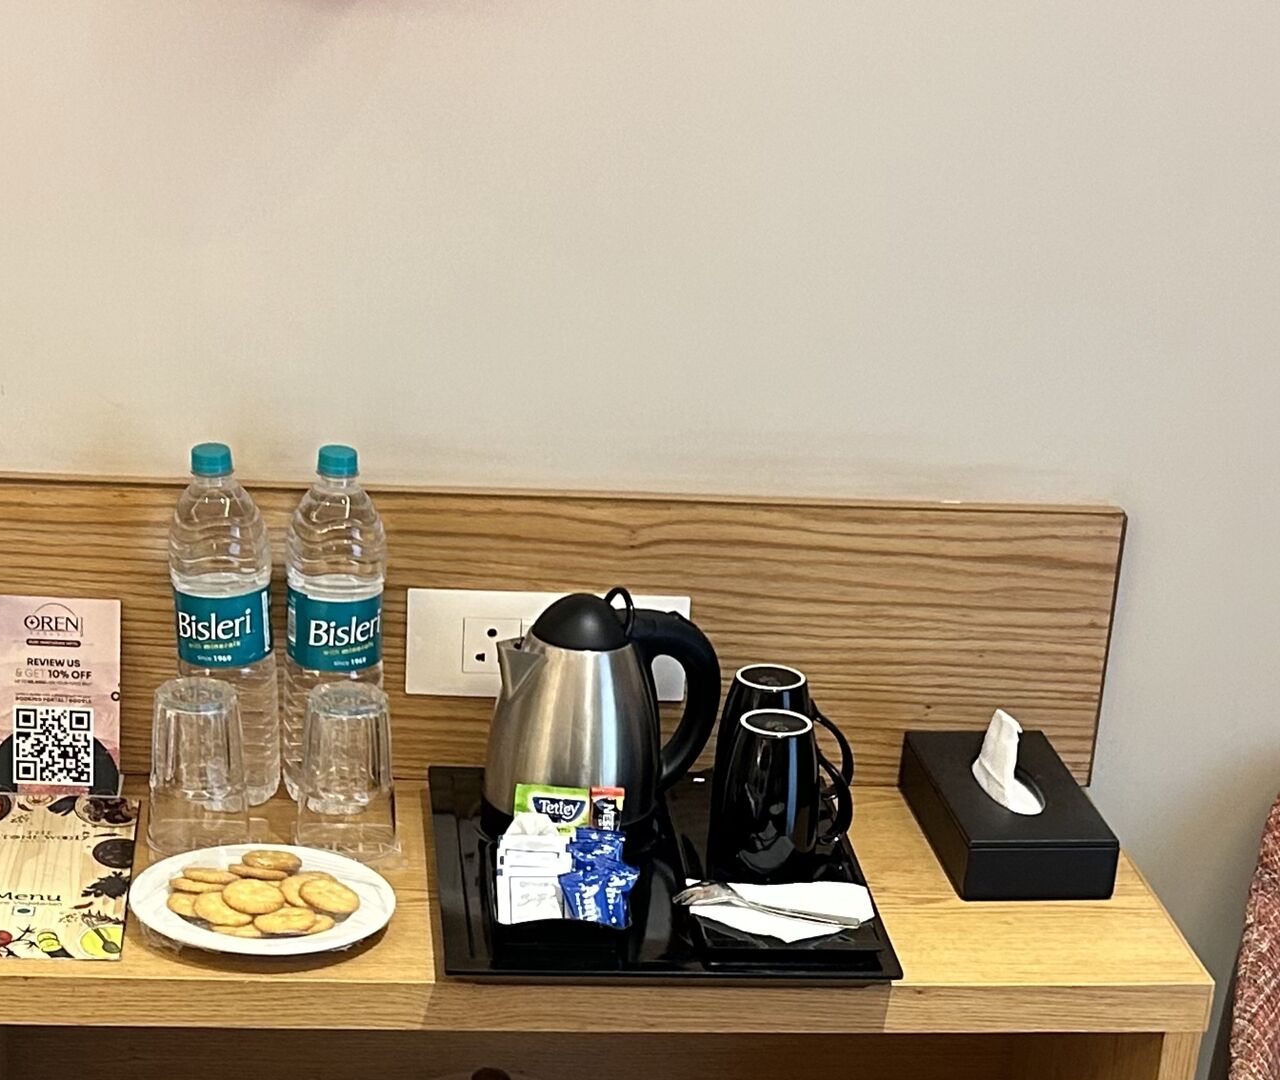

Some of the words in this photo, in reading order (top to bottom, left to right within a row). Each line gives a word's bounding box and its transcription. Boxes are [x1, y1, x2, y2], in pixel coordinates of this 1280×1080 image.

[24, 615, 79, 632] OREN
[178, 607, 251, 641] Bisleri
[308, 608, 381, 647] Bisleri
[26, 657, 65, 667] REVIEW
[67, 658, 81, 668] US
[25, 668, 47, 679] GET
[48, 669, 70, 680] 10%
[71, 670, 92, 680] OFF
[538, 799, 581, 820] Tetley
